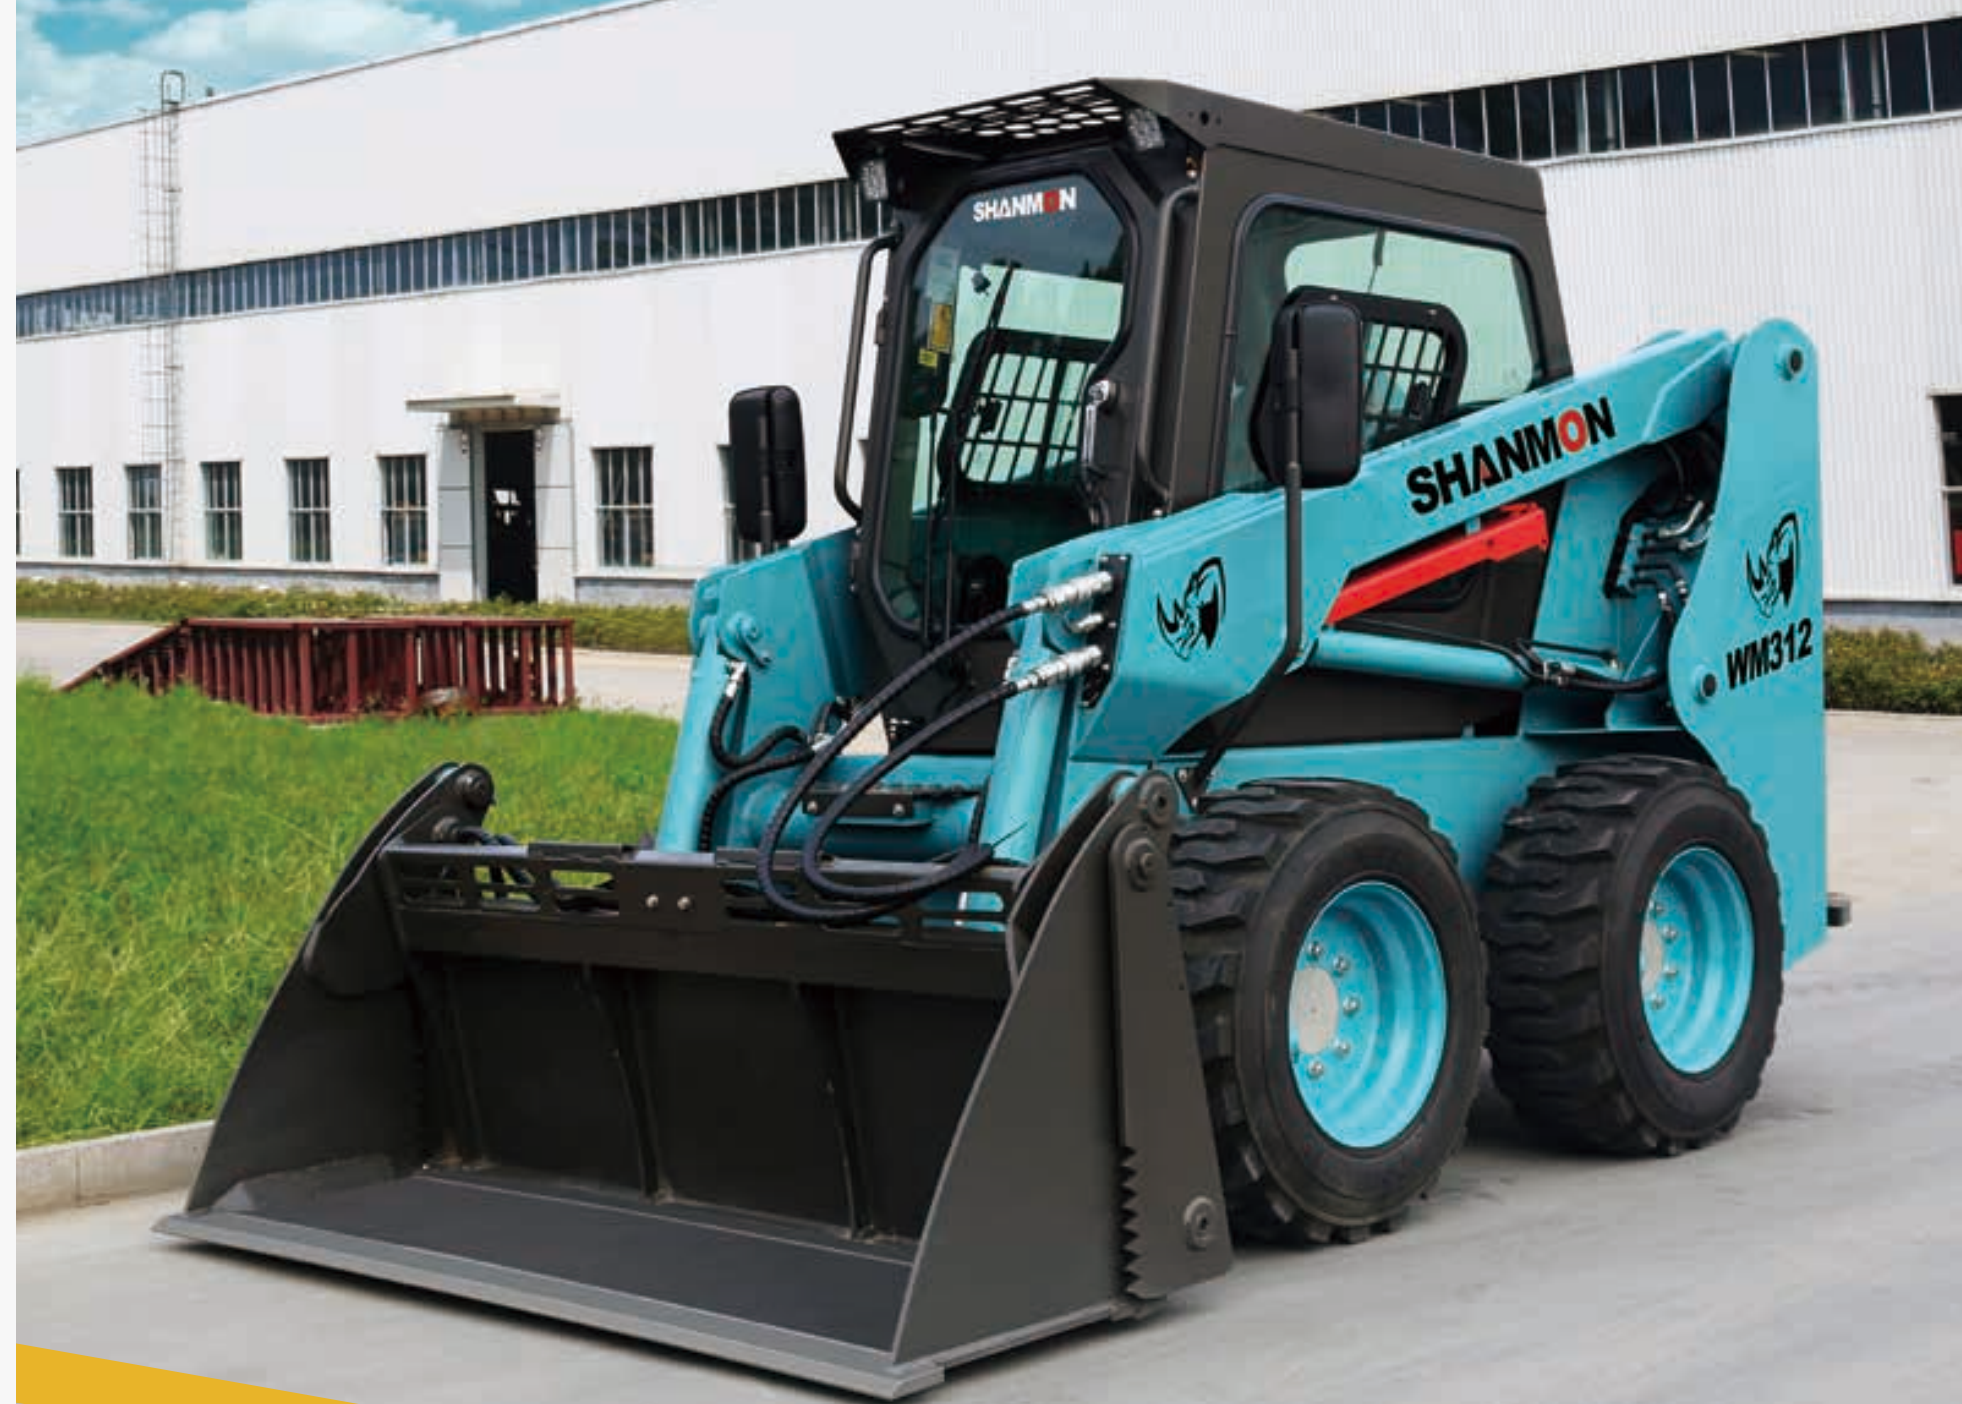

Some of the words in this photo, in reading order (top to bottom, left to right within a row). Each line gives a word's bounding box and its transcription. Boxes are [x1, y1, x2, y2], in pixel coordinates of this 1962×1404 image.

[973, 187, 1077, 222] SHANMON
[1407, 396, 1616, 515] SHANMON
[1727, 617, 1812, 690] WM312
